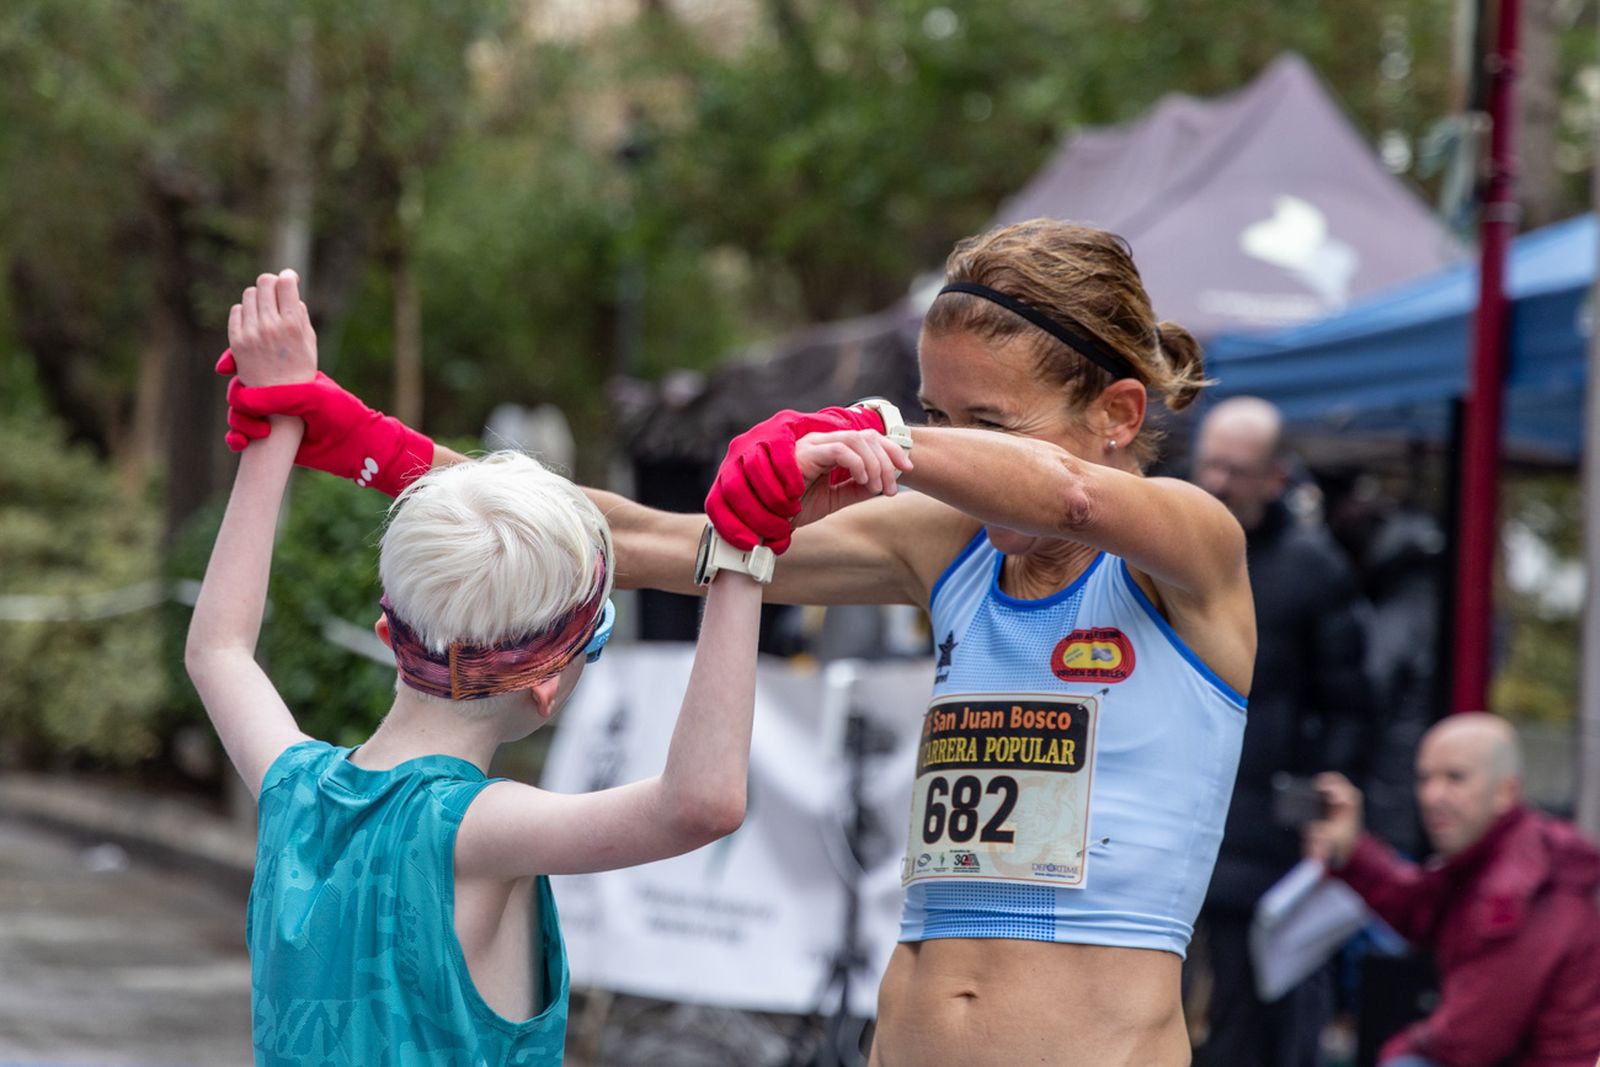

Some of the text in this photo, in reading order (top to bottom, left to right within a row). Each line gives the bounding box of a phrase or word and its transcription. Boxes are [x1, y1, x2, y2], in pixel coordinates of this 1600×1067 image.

[933, 709, 956, 733] San
[960, 706, 1004, 730] Juan
[1010, 705, 1072, 730] Bosco
[983, 736, 1076, 766] POPULAR
[922, 775, 1019, 845] 682
